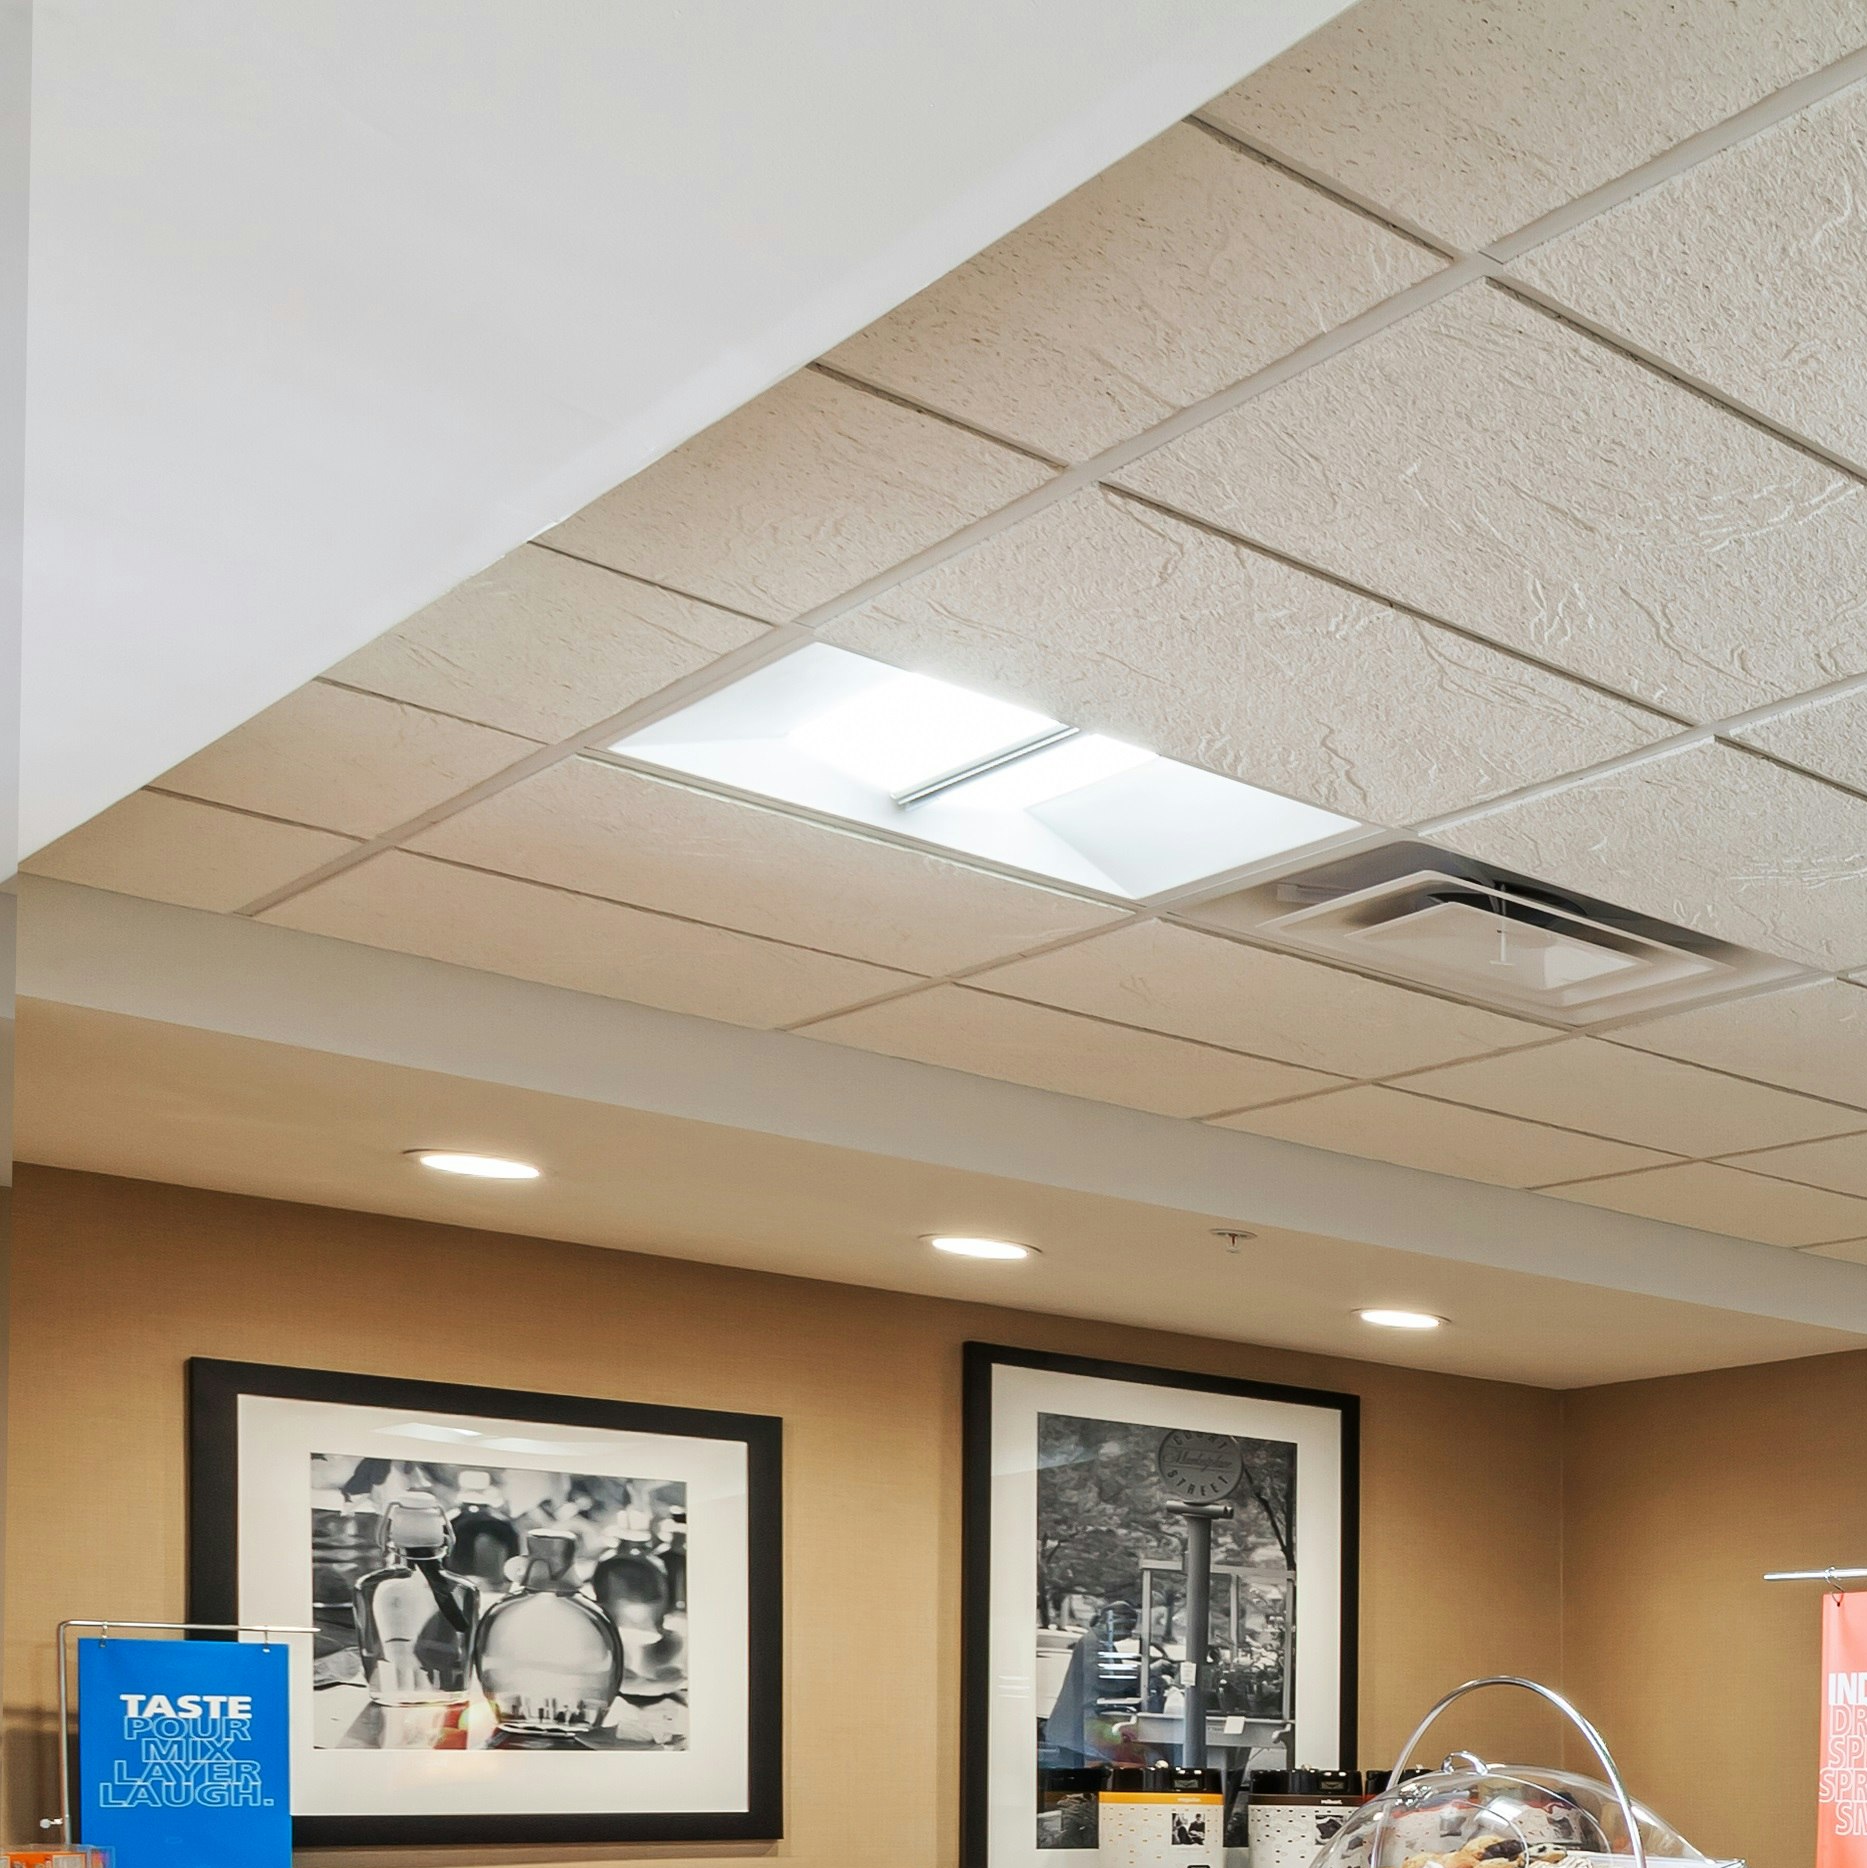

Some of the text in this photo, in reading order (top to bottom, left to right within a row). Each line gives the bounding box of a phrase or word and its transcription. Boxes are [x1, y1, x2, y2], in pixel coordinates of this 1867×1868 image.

[119, 1694, 252, 1719] TASTE
[124, 1716, 251, 1741] POUR
[142, 1738, 235, 1763] MIX
[114, 1760, 262, 1785] LAYER
[100, 1782, 274, 1808] LAUGH.
